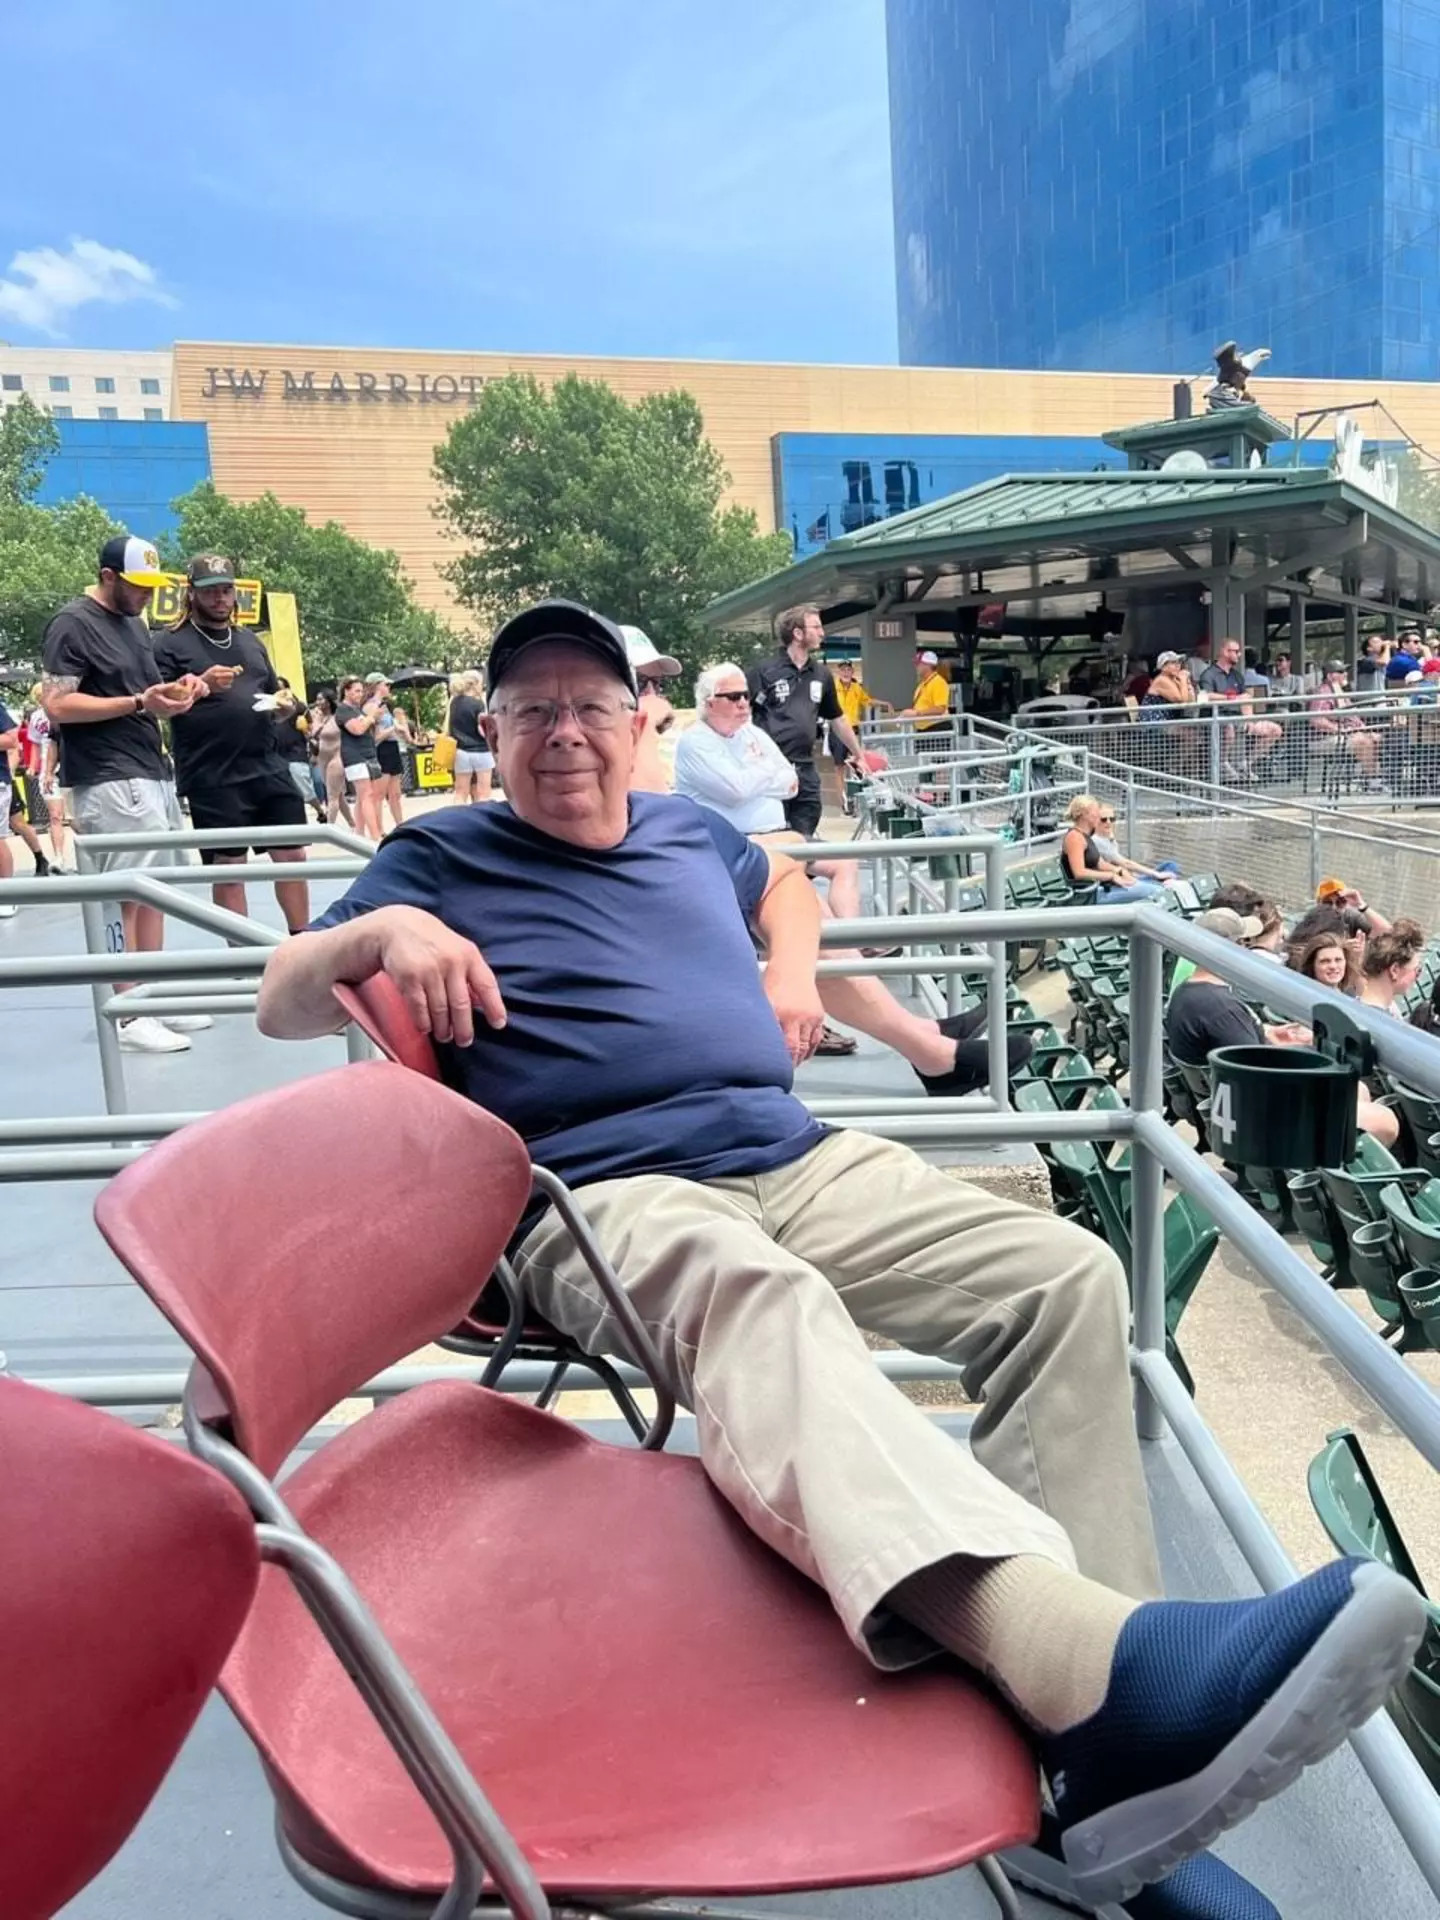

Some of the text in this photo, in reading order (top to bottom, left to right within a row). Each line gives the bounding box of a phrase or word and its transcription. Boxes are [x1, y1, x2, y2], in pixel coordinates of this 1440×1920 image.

[202, 366, 502, 404] JW MARRIOT
[1211, 1082, 1237, 1145] 4
